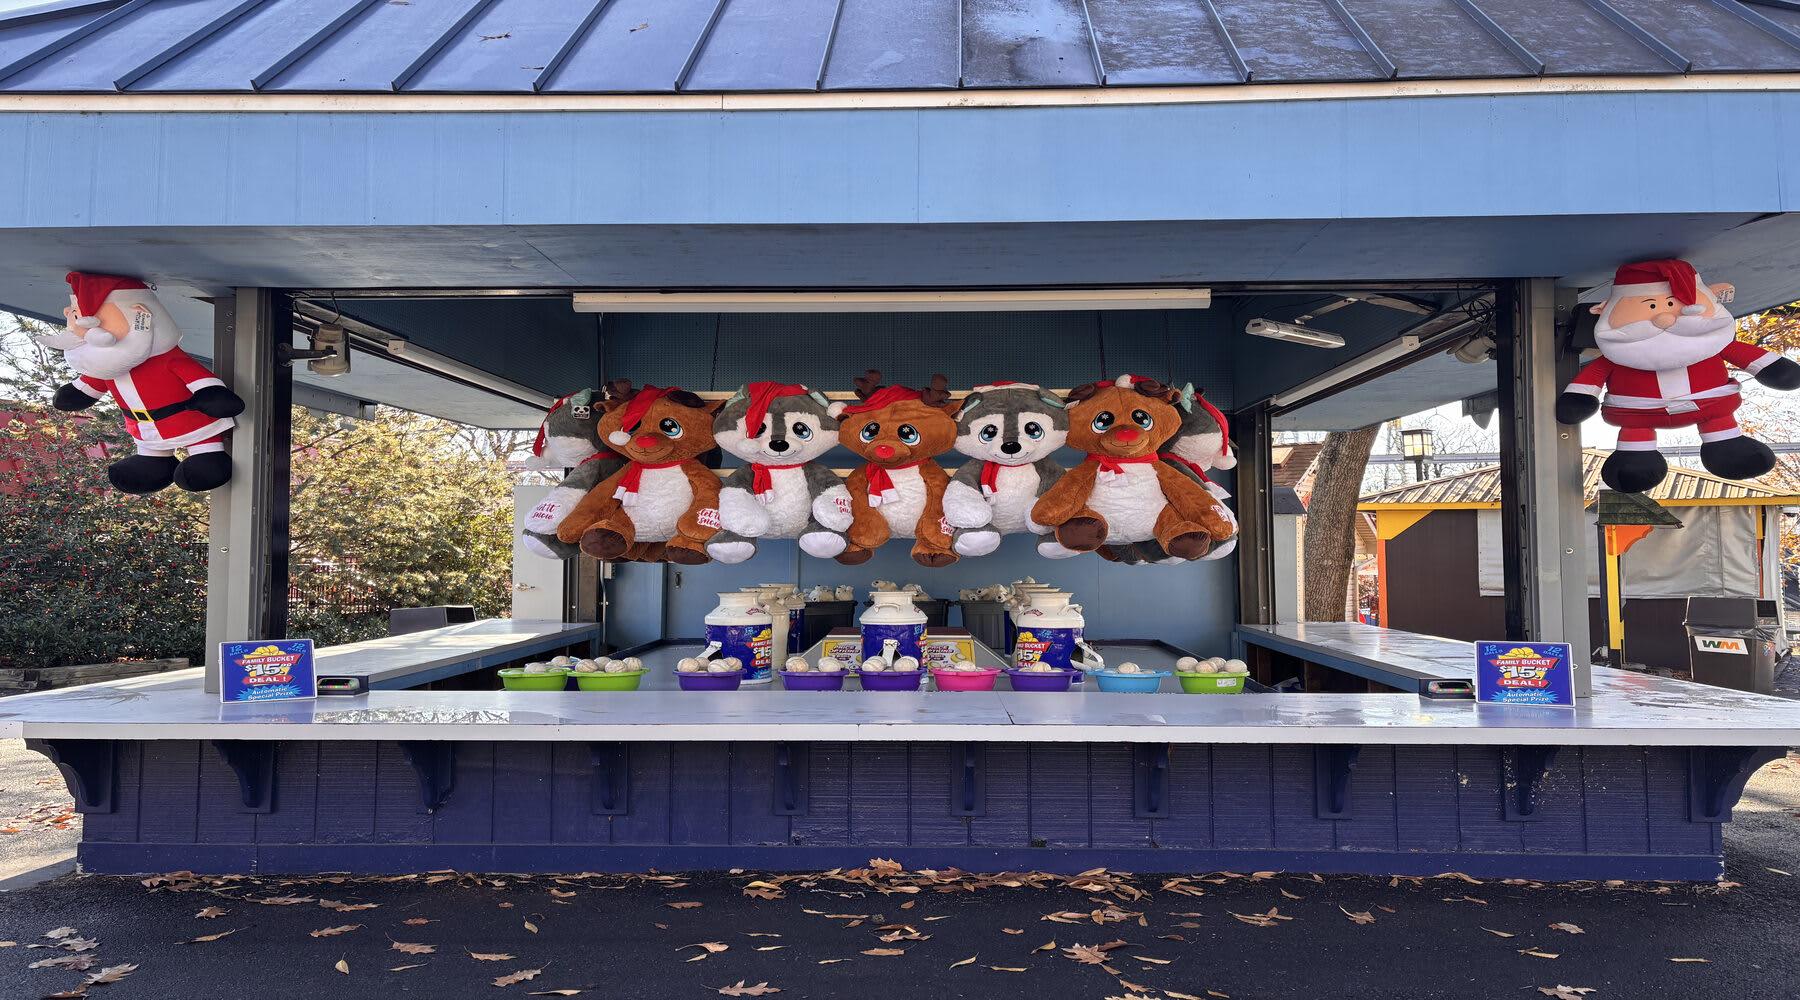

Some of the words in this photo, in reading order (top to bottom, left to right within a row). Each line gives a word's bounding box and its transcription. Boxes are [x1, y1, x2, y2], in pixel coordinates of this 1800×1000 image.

[230, 644, 242, 653] 12
[1484, 644, 1497, 652] 12
[1548, 645, 1563, 654] 12
[1702, 639, 1740, 651] WM
[266, 655, 295, 663] BUCKET
[247, 692, 274, 701] Special
[275, 690, 294, 698] Prize
[251, 687, 288, 696] Automatic
